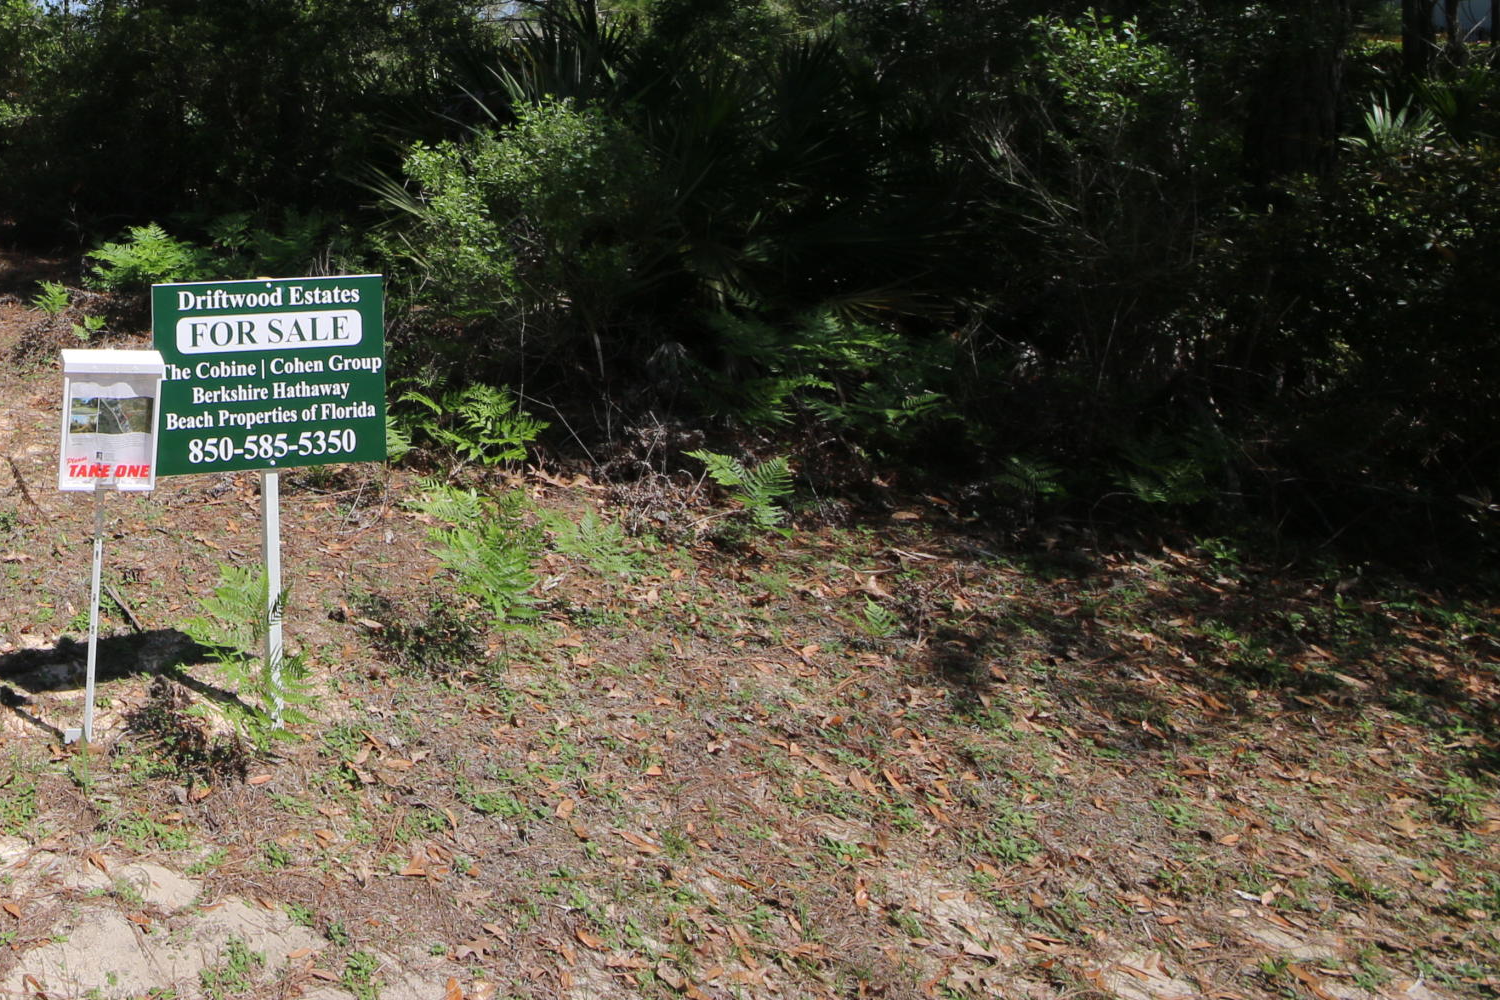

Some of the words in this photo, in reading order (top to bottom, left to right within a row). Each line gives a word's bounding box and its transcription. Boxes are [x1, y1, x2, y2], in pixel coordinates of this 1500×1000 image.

[178, 287, 283, 310] Driftwood
[289, 286, 360, 306] Estates
[189, 320, 258, 348] FOR
[267, 315, 350, 344] SALE
[196, 362, 257, 379] Cobine
[270, 357, 323, 375] Cohen
[328, 354, 382, 373] Group
[192, 385, 269, 404] Berkshire
[272, 381, 350, 399] Hathaway
[166, 412, 214, 430] Beach
[218, 406, 298, 429] Properties
[302, 405, 318, 422] of
[321, 401, 376, 420] Florida
[188, 428, 357, 464] 850-585-5350
[69, 464, 111, 478] TAKE
[114, 464, 151, 478] ONE
